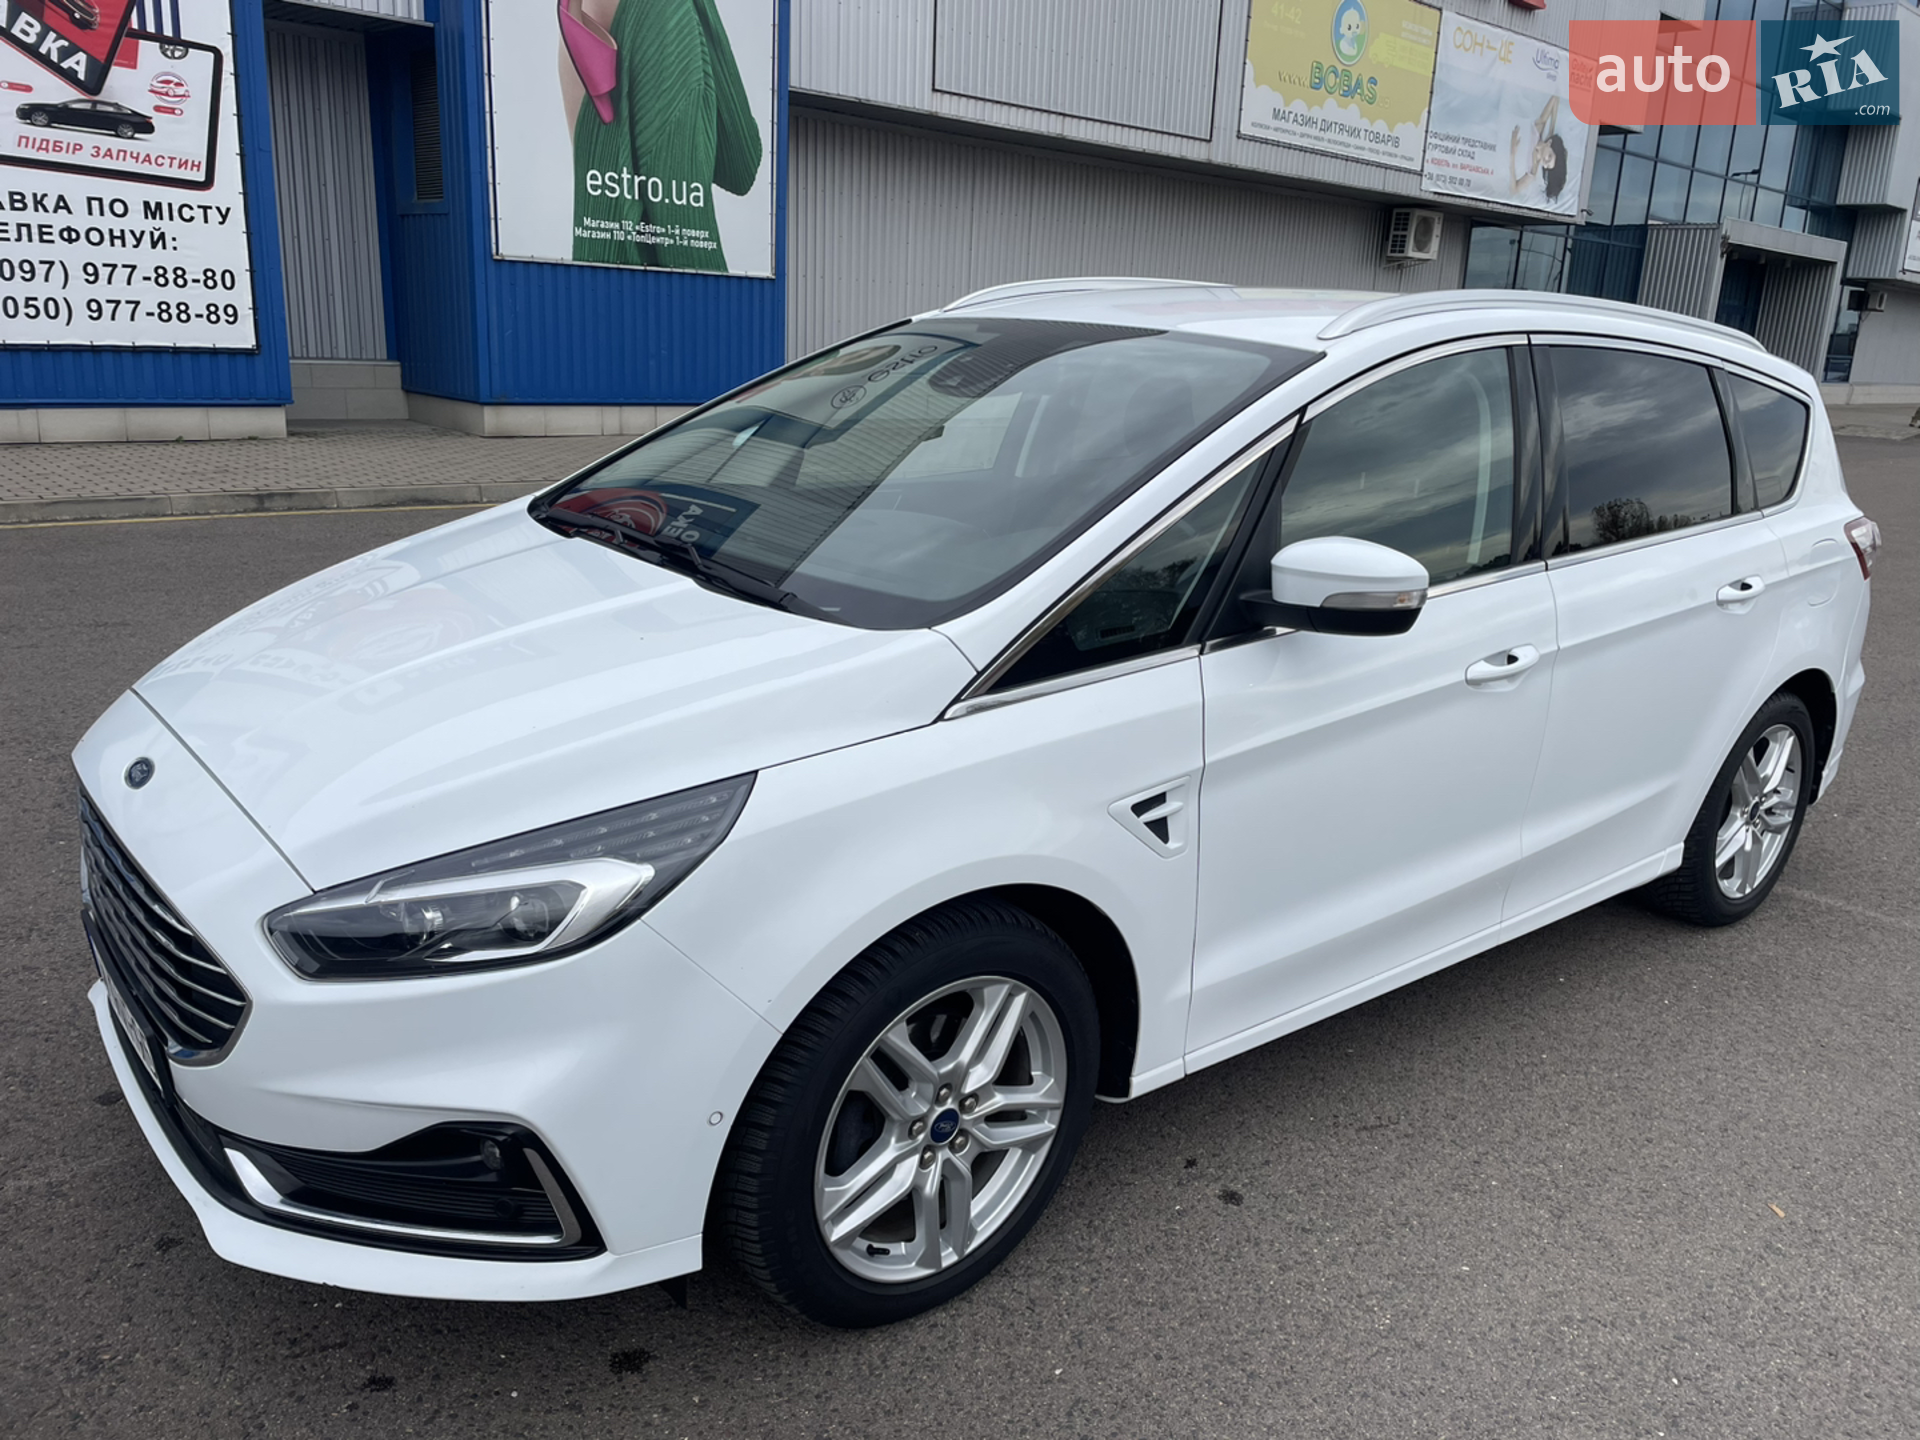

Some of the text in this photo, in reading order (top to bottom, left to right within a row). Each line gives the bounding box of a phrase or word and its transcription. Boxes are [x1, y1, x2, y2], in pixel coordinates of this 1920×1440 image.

[1271, 107, 1401, 149] МАГАЗИН ДИТЯЧИХ ТОВАРІВ
[17, 135, 203, 173] ПІДБІР ЗАПЧАСТИН
[585, 166, 705, 208] estro.ua
[86, 196, 129, 218] ПО
[143, 201, 232, 225] МІСТУ
[574, 226, 611, 240] Магазин
[613, 230, 625, 241] 110
[675, 236, 688, 247] 1-й
[689, 239, 717, 252] поверх
[583, 216, 620, 230] Магазин
[622, 219, 634, 231] 112
[667, 224, 680, 235] 1-й
[681, 227, 709, 239] поверх
[82, 261, 237, 292] 977-88-80
[2, 295, 240, 327] 050) 977-88-89
